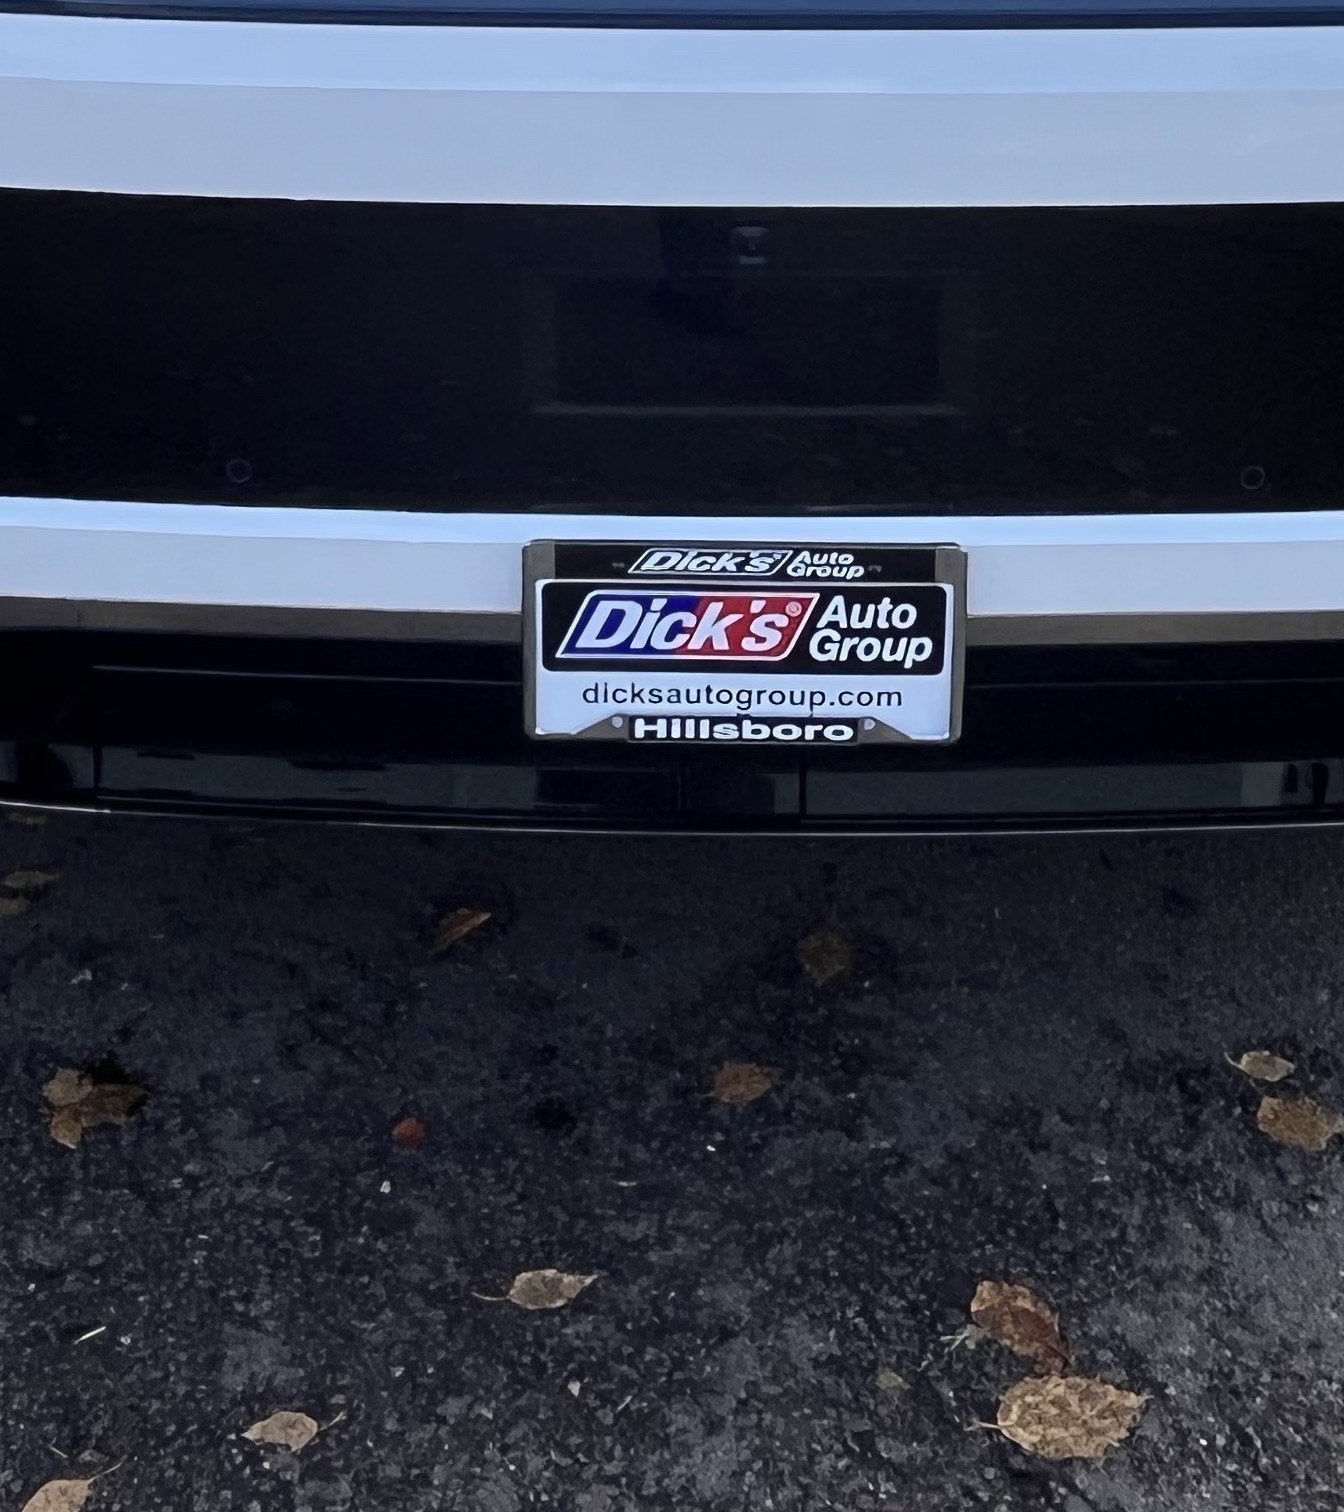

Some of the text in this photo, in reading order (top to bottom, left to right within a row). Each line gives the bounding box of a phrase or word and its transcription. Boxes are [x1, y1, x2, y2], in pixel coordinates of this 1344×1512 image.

[641, 549, 779, 573] Dick's
[786, 563, 865, 580] Group
[794, 551, 855, 566] Auto
[575, 598, 789, 652] Dick's
[816, 595, 918, 630] Auto
[808, 629, 934, 670] Group
[581, 682, 904, 712] dicksautogroup.com
[633, 717, 855, 742] Hillsboro
